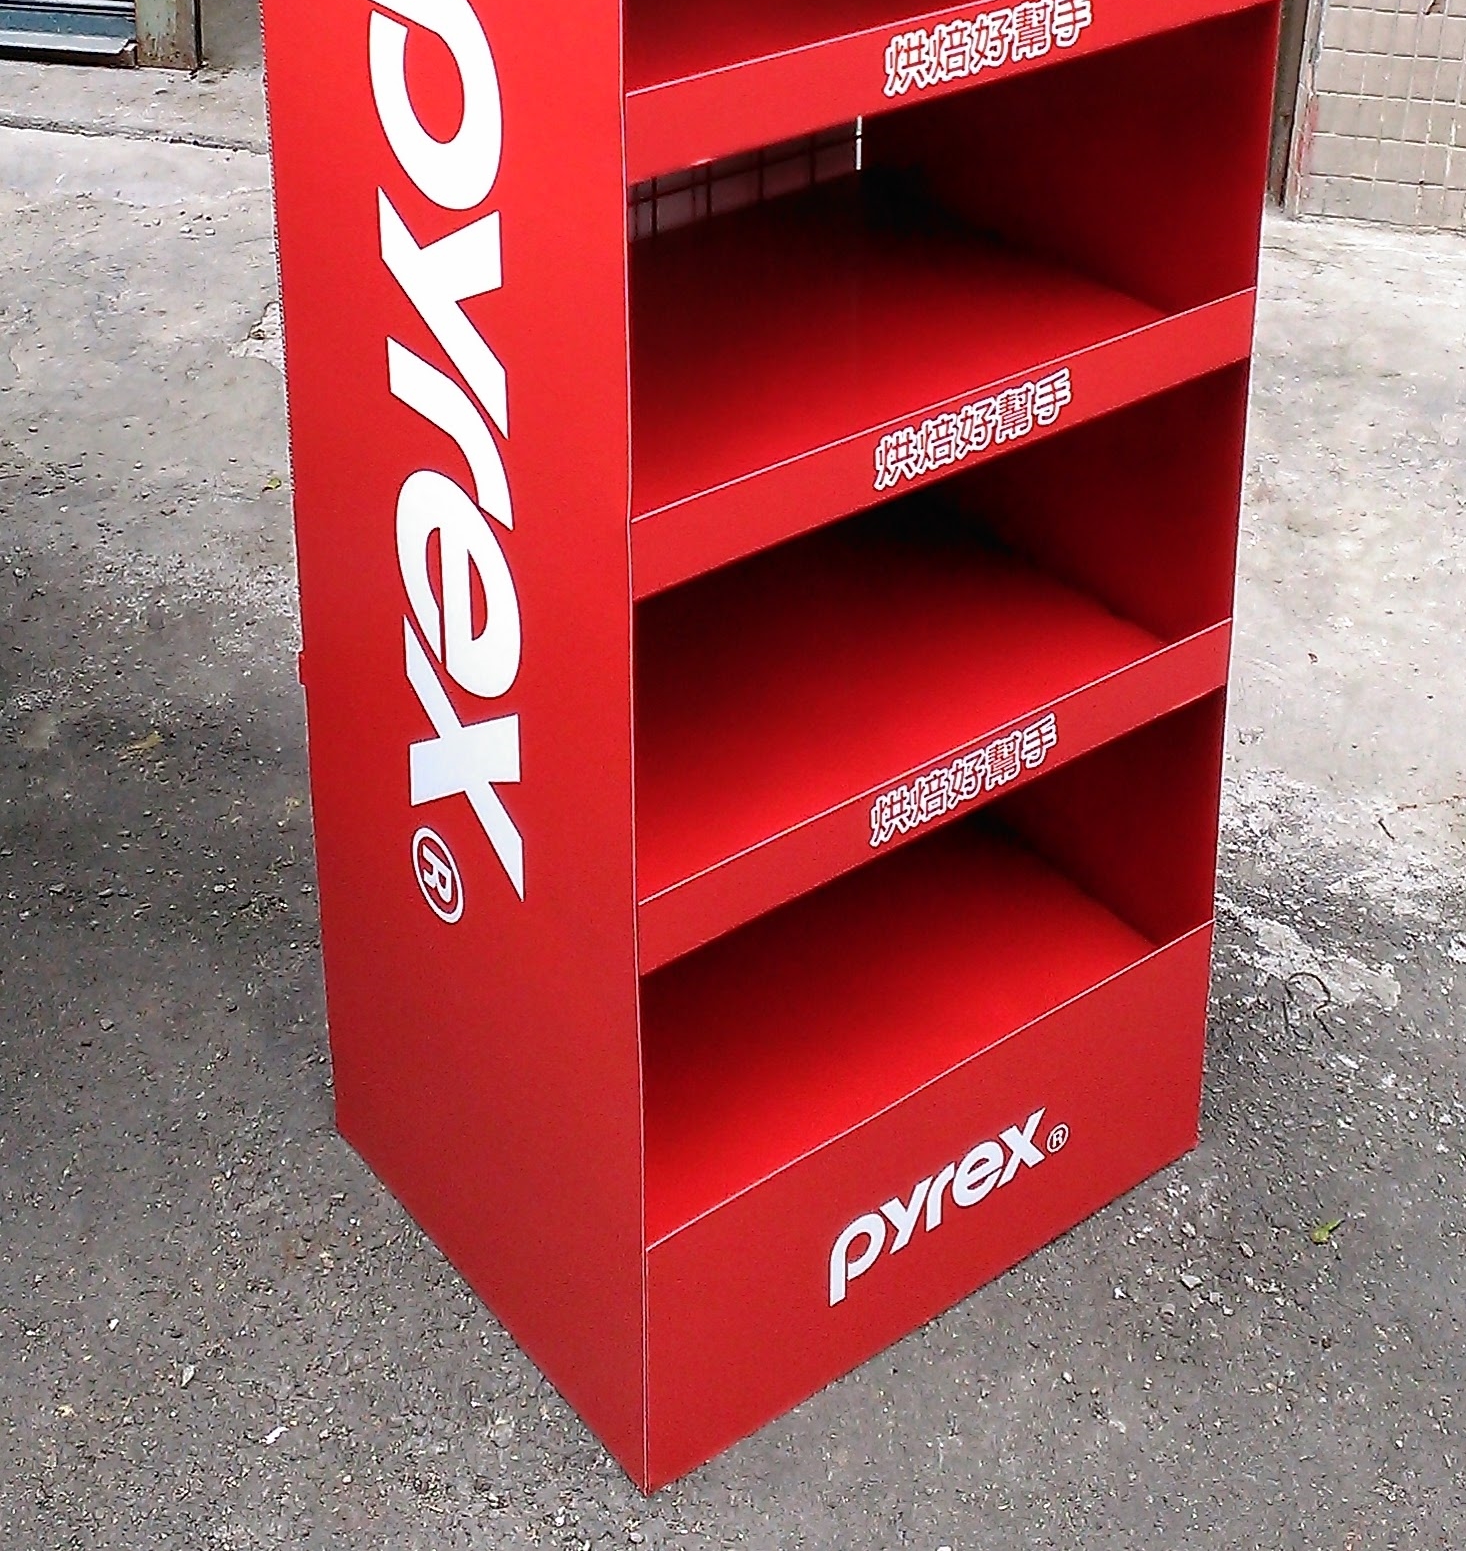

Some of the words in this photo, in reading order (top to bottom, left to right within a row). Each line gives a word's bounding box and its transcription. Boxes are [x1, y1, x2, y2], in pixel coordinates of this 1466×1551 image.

[873, 366, 1072, 491] 烘焙好幫手
[869, 712, 1058, 847] 烘焙好幫手
